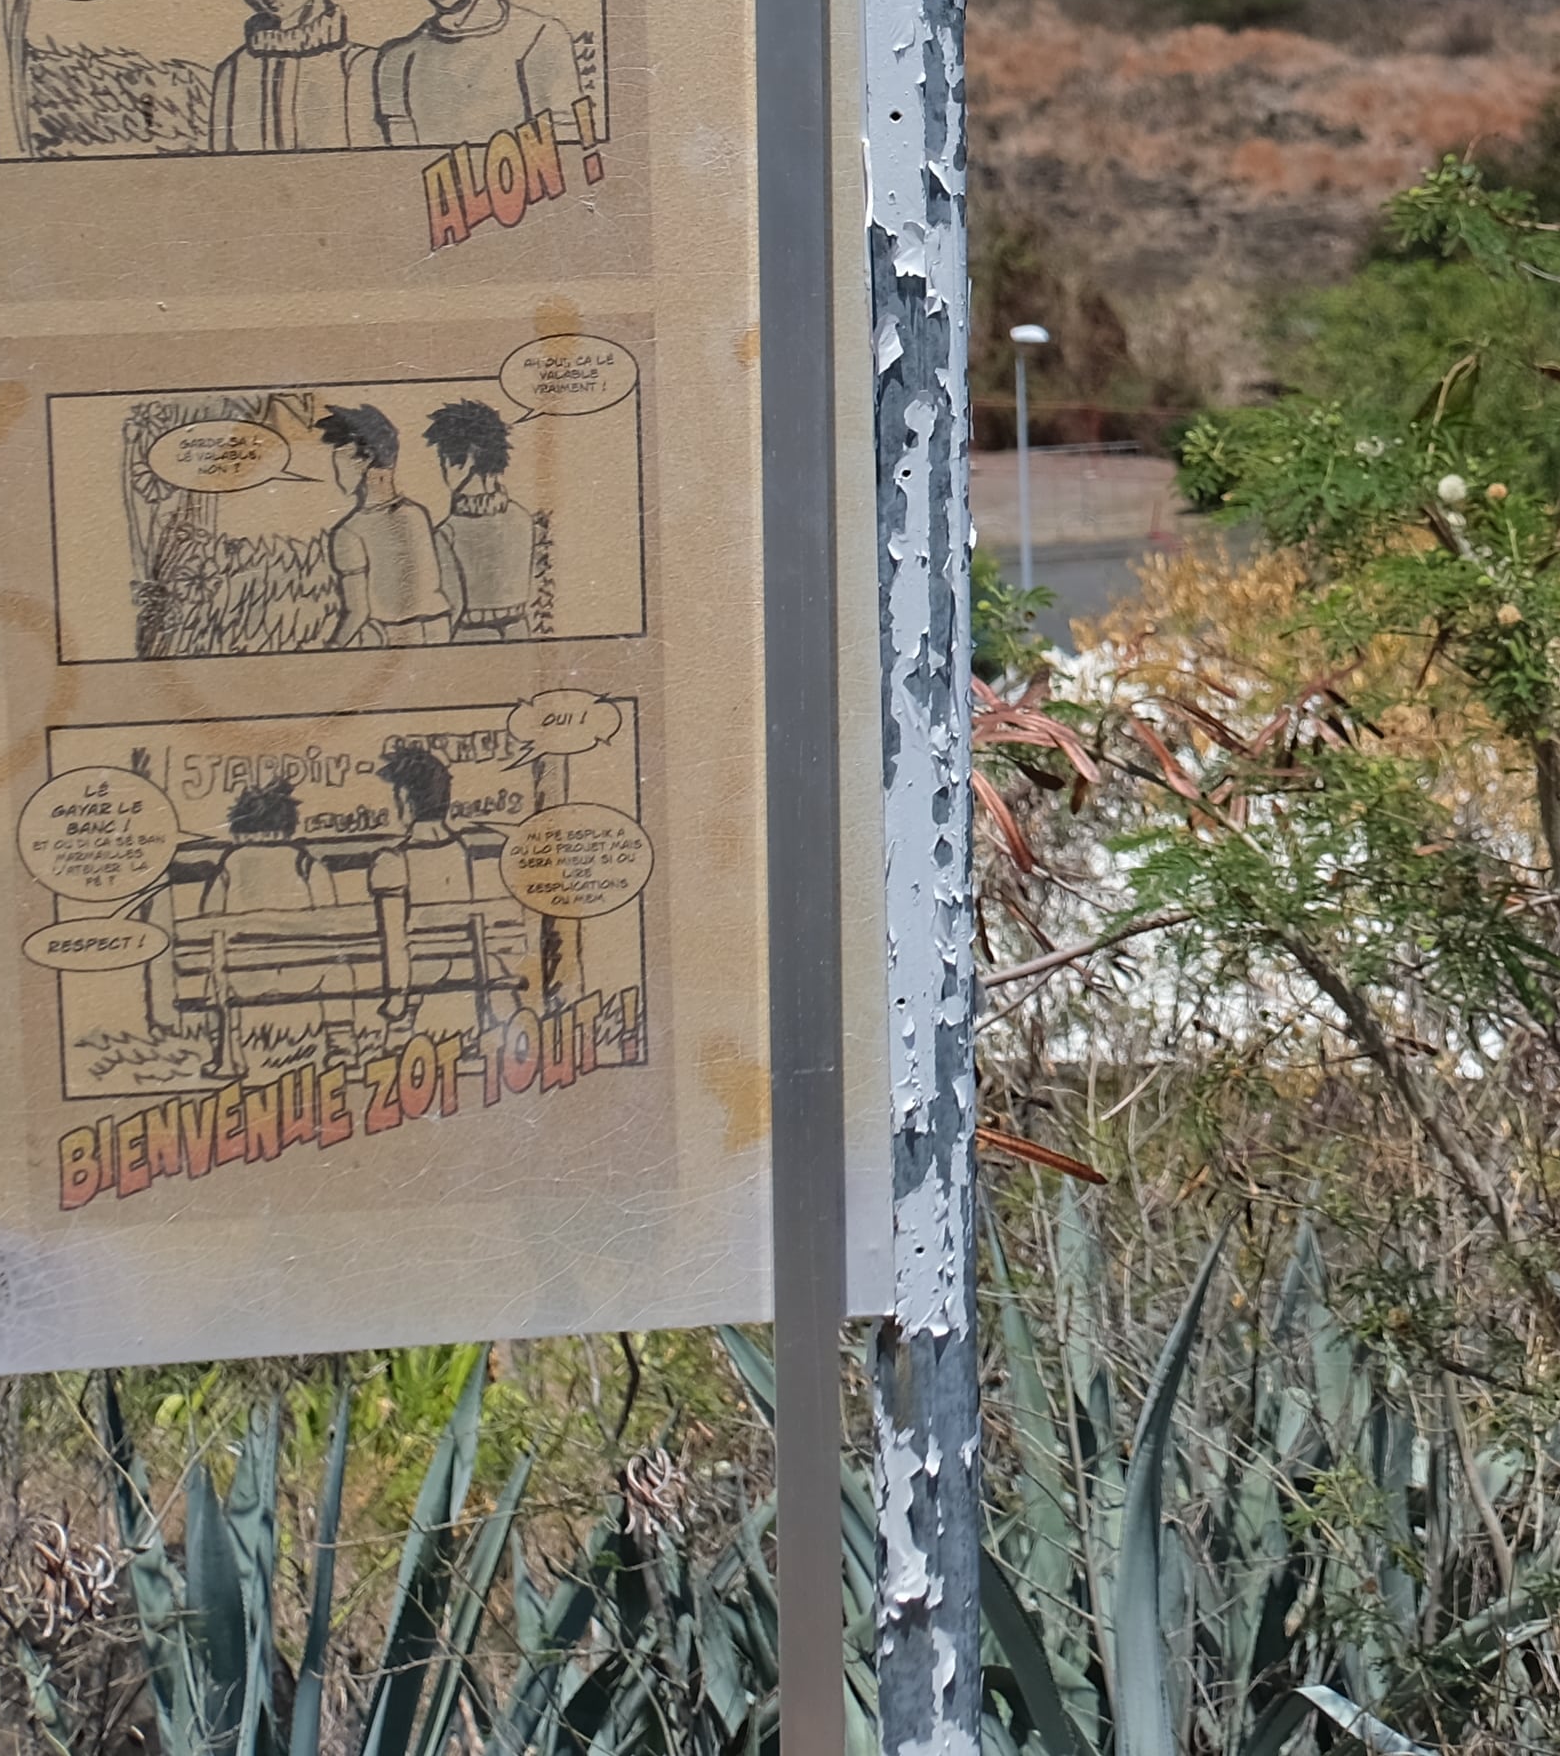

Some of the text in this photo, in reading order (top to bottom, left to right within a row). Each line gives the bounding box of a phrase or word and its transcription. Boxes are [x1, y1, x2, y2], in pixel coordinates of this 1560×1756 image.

[66, 820, 115, 836] BANC
[47, 935, 132, 955] RESPECT
[59, 990, 604, 1211] BIENVENUE ZOT TOUT
